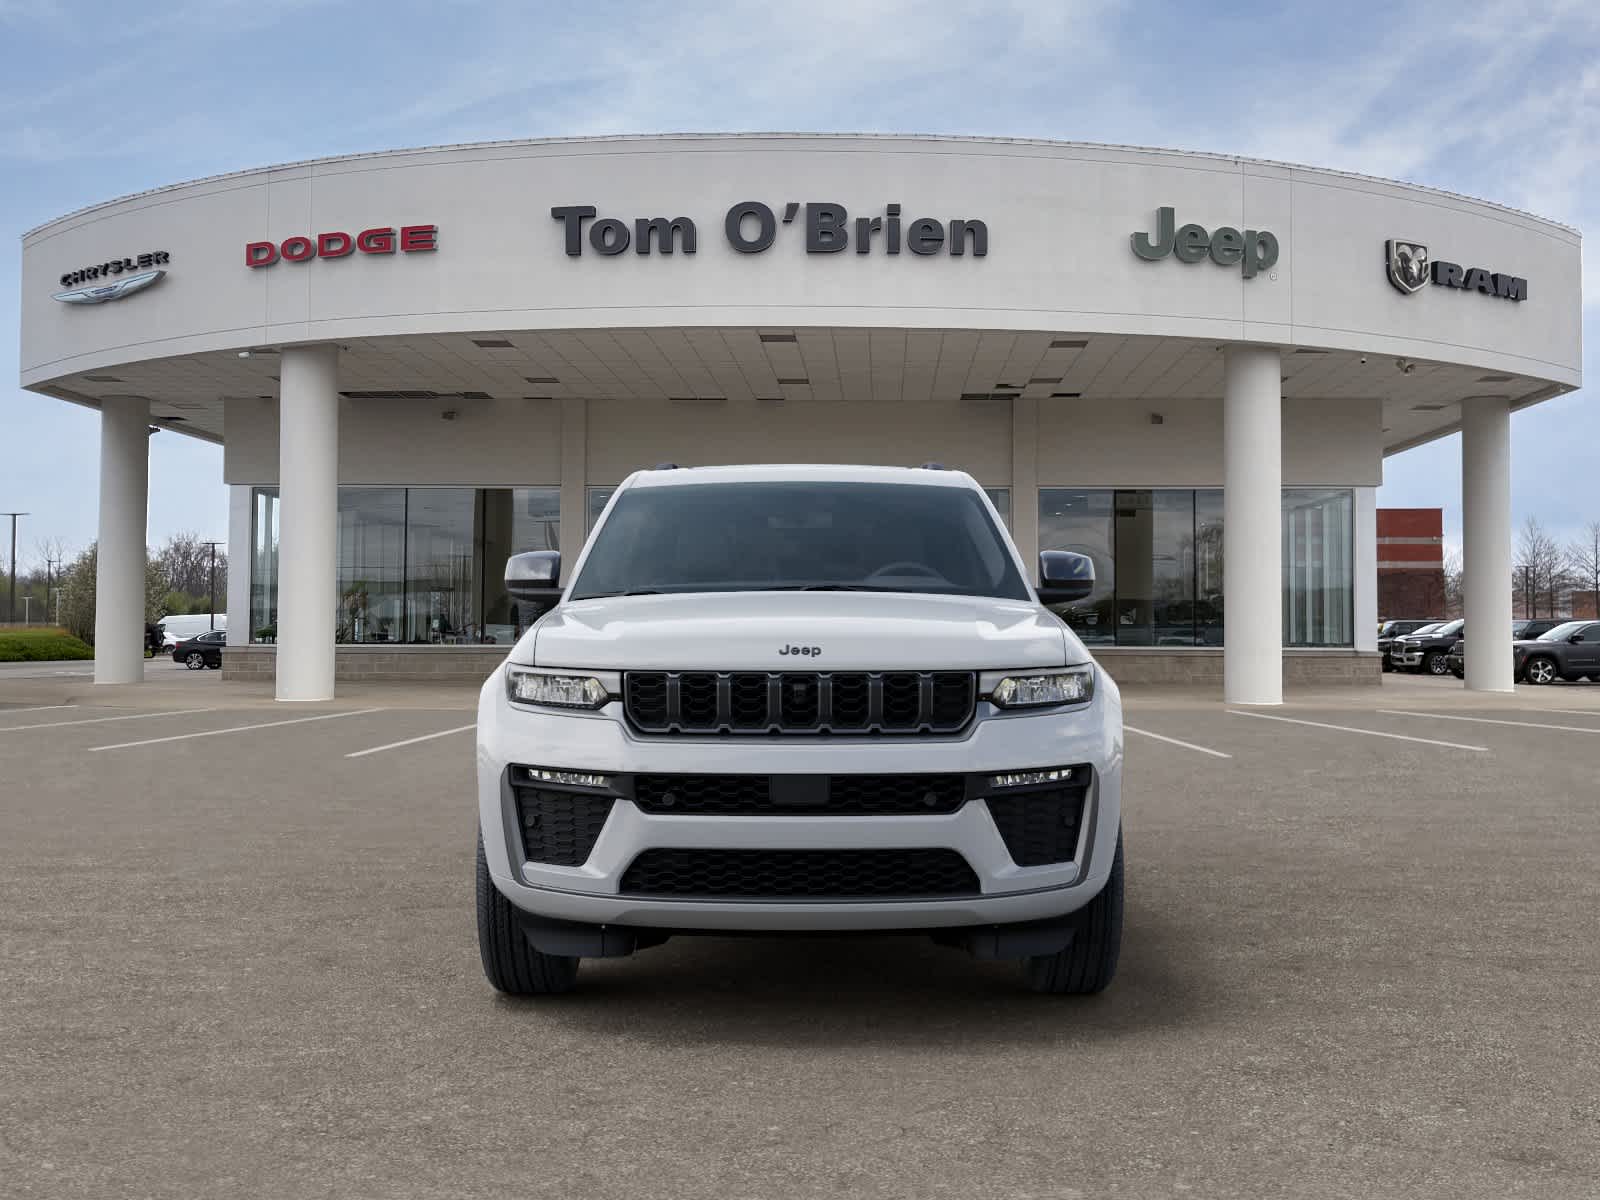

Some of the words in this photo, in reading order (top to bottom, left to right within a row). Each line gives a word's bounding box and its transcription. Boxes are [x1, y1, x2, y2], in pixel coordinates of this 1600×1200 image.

[246, 224, 437, 267] DODGE
[551, 205, 697, 256] Tom
[725, 201, 989, 256] O’Brien
[1130, 206, 1279, 277] Jeep
[61, 250, 170, 287] CHRYSLER
[1430, 261, 1528, 302] RAM
[778, 644, 822, 658] Jeep
